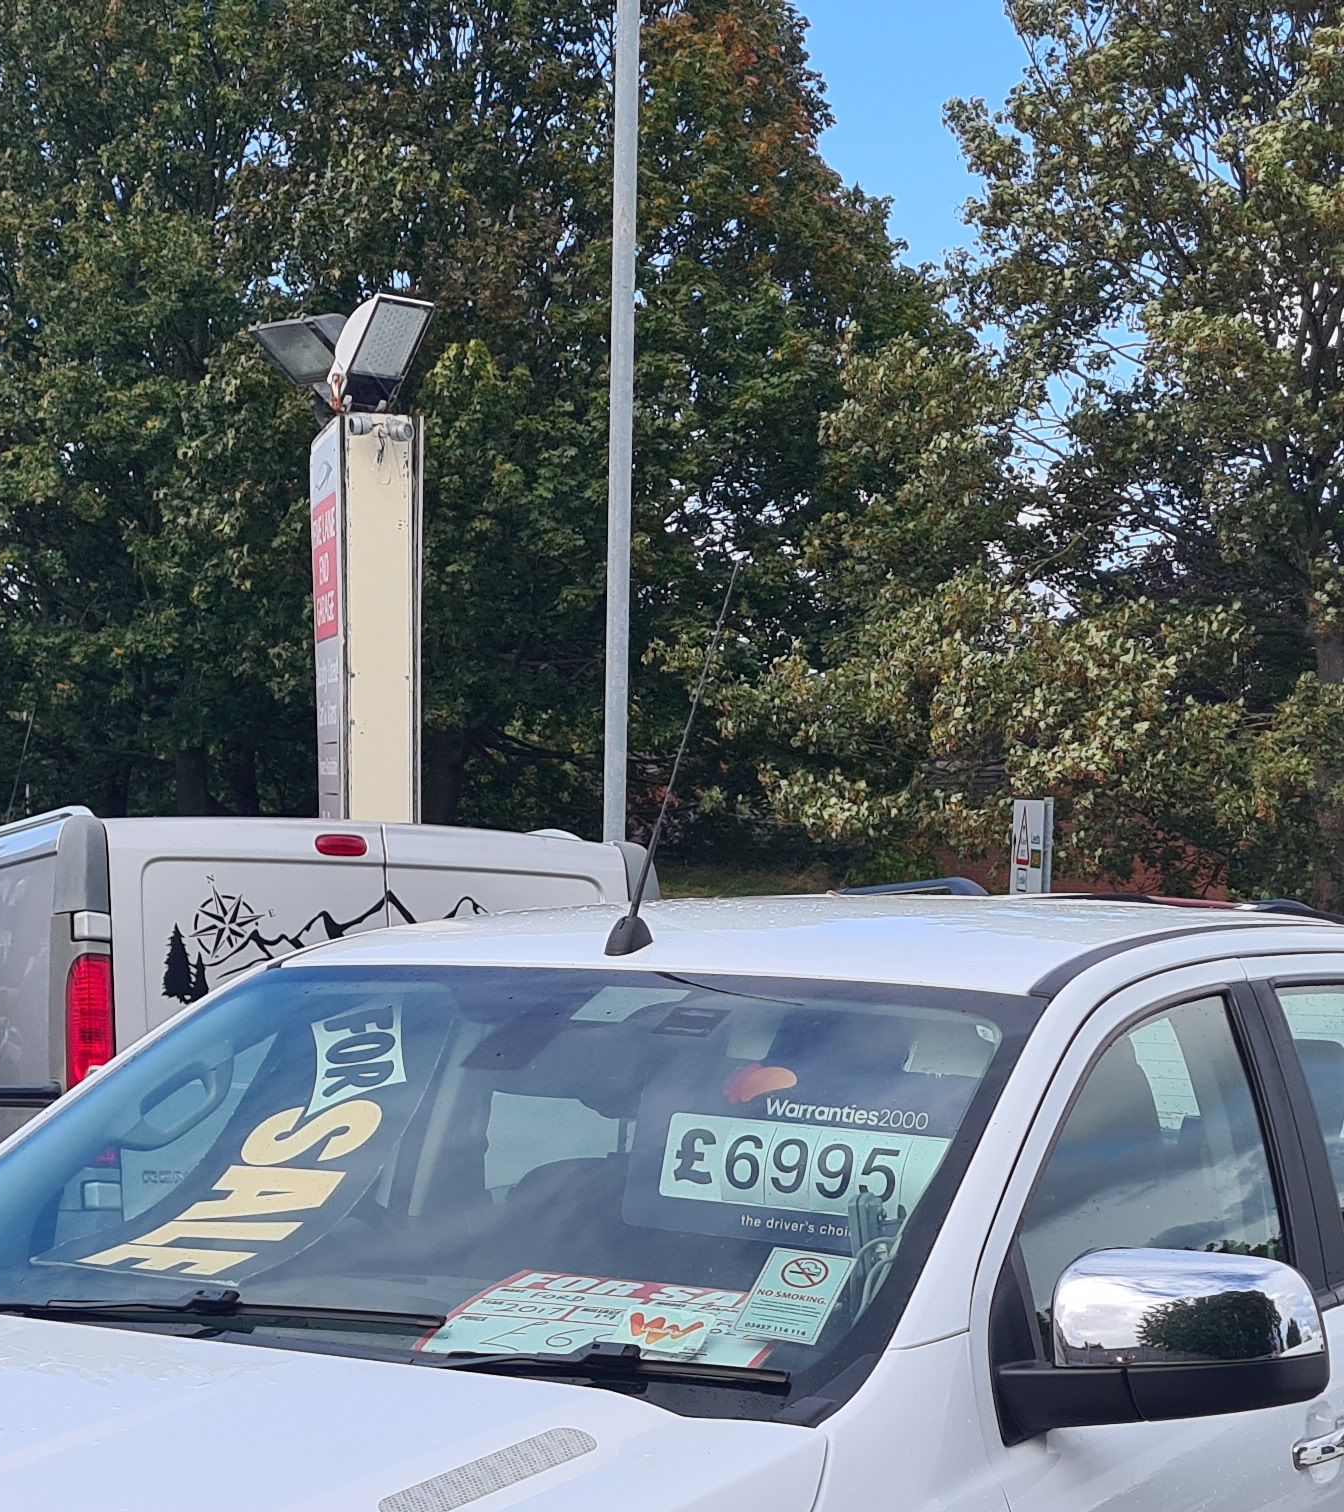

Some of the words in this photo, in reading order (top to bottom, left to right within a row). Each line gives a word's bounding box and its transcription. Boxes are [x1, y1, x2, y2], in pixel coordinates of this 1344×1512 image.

[322, 1008, 396, 1098] FOR
[765, 1097, 930, 1131] Warranties2000
[673, 1126, 901, 1204] £6995
[76, 1099, 384, 1276] SALE
[741, 1214, 762, 1229] the
[765, 1216, 816, 1235] driver's
[507, 1271, 645, 1298] FOR
[648, 1285, 744, 1307] SA
[530, 1290, 586, 1304] FORD
[756, 1288, 774, 1298] NO
[493, 1303, 567, 1317] 2017
